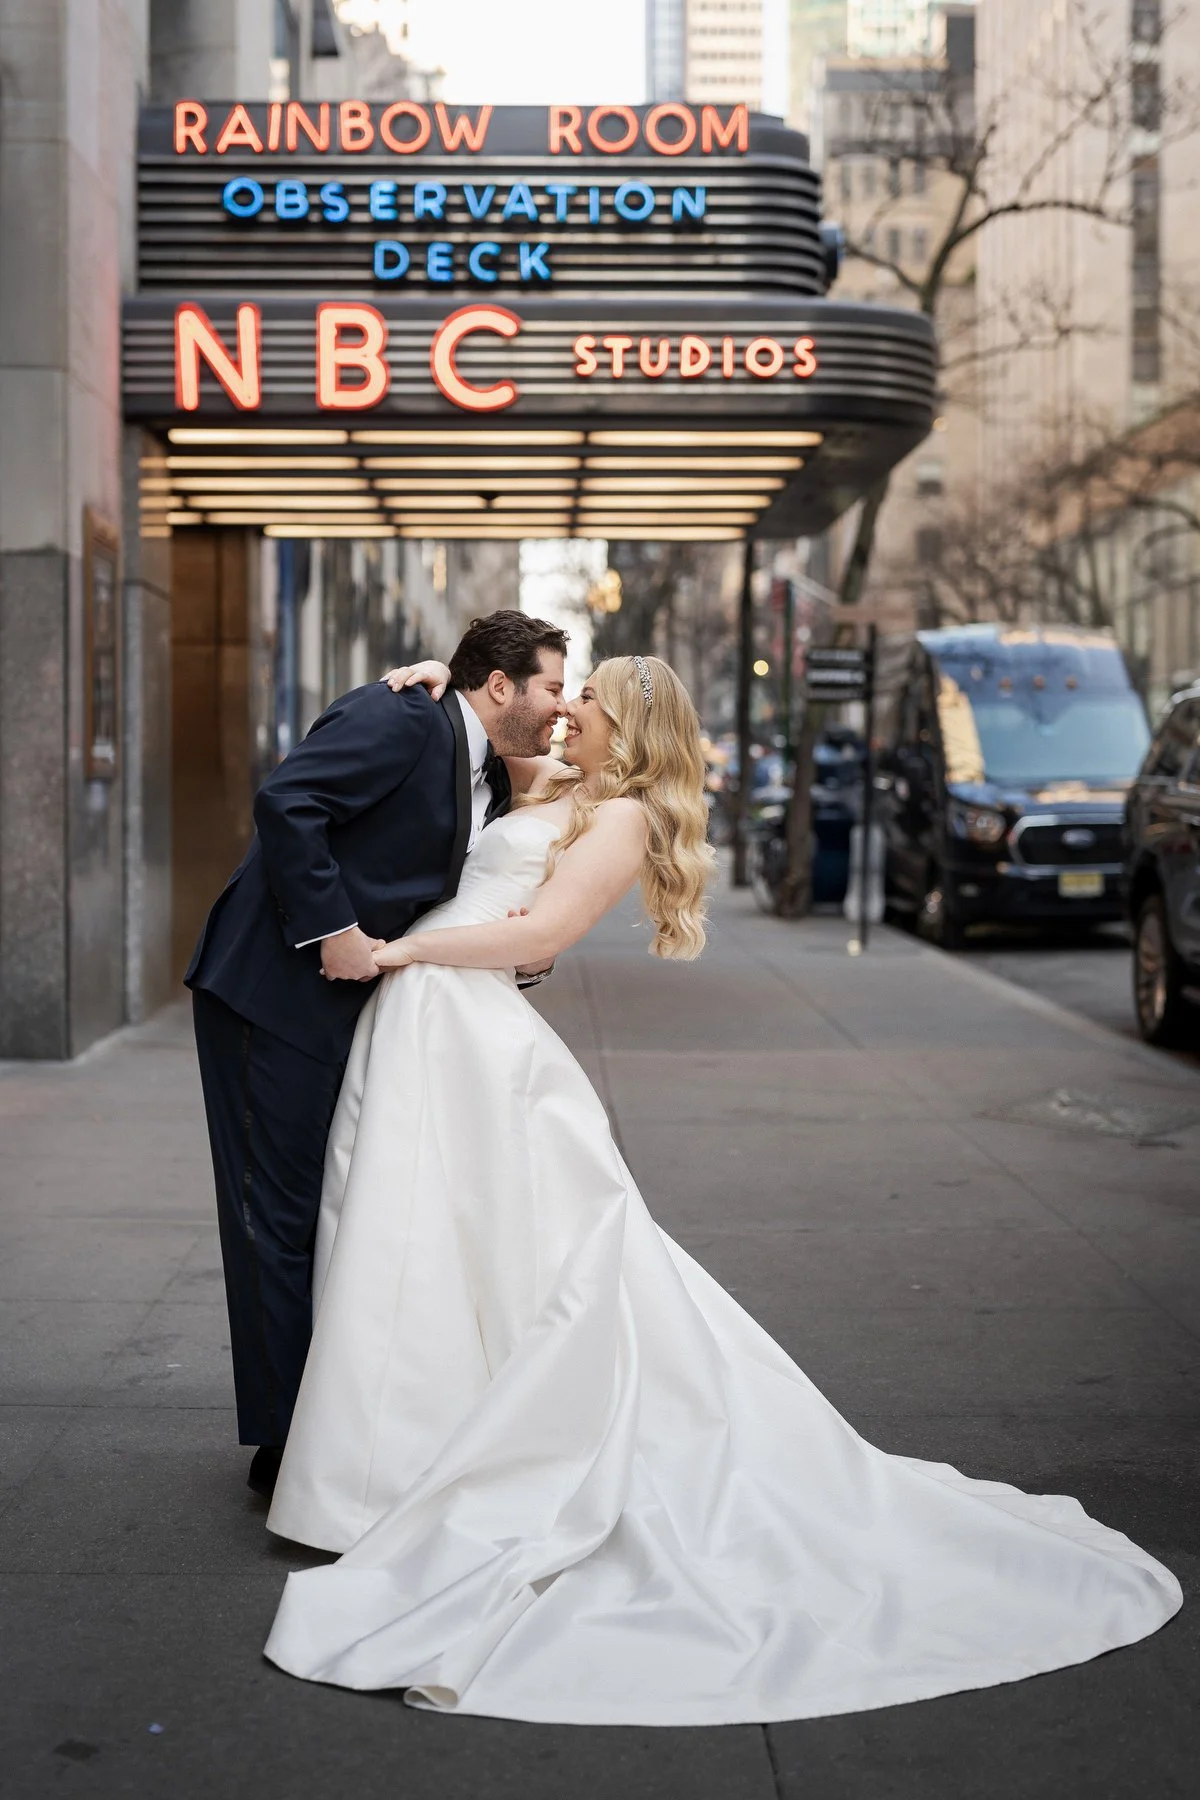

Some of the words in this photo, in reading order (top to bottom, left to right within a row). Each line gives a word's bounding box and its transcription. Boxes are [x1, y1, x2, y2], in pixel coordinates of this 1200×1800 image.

[174, 101, 493, 154] RAINBOW
[549, 103, 749, 154] ROOM
[223, 177, 707, 222] OBSERVATION
[373, 241, 552, 282] DECK
[174, 303, 521, 412] NBC
[573, 335, 817, 378] STUDIOS
